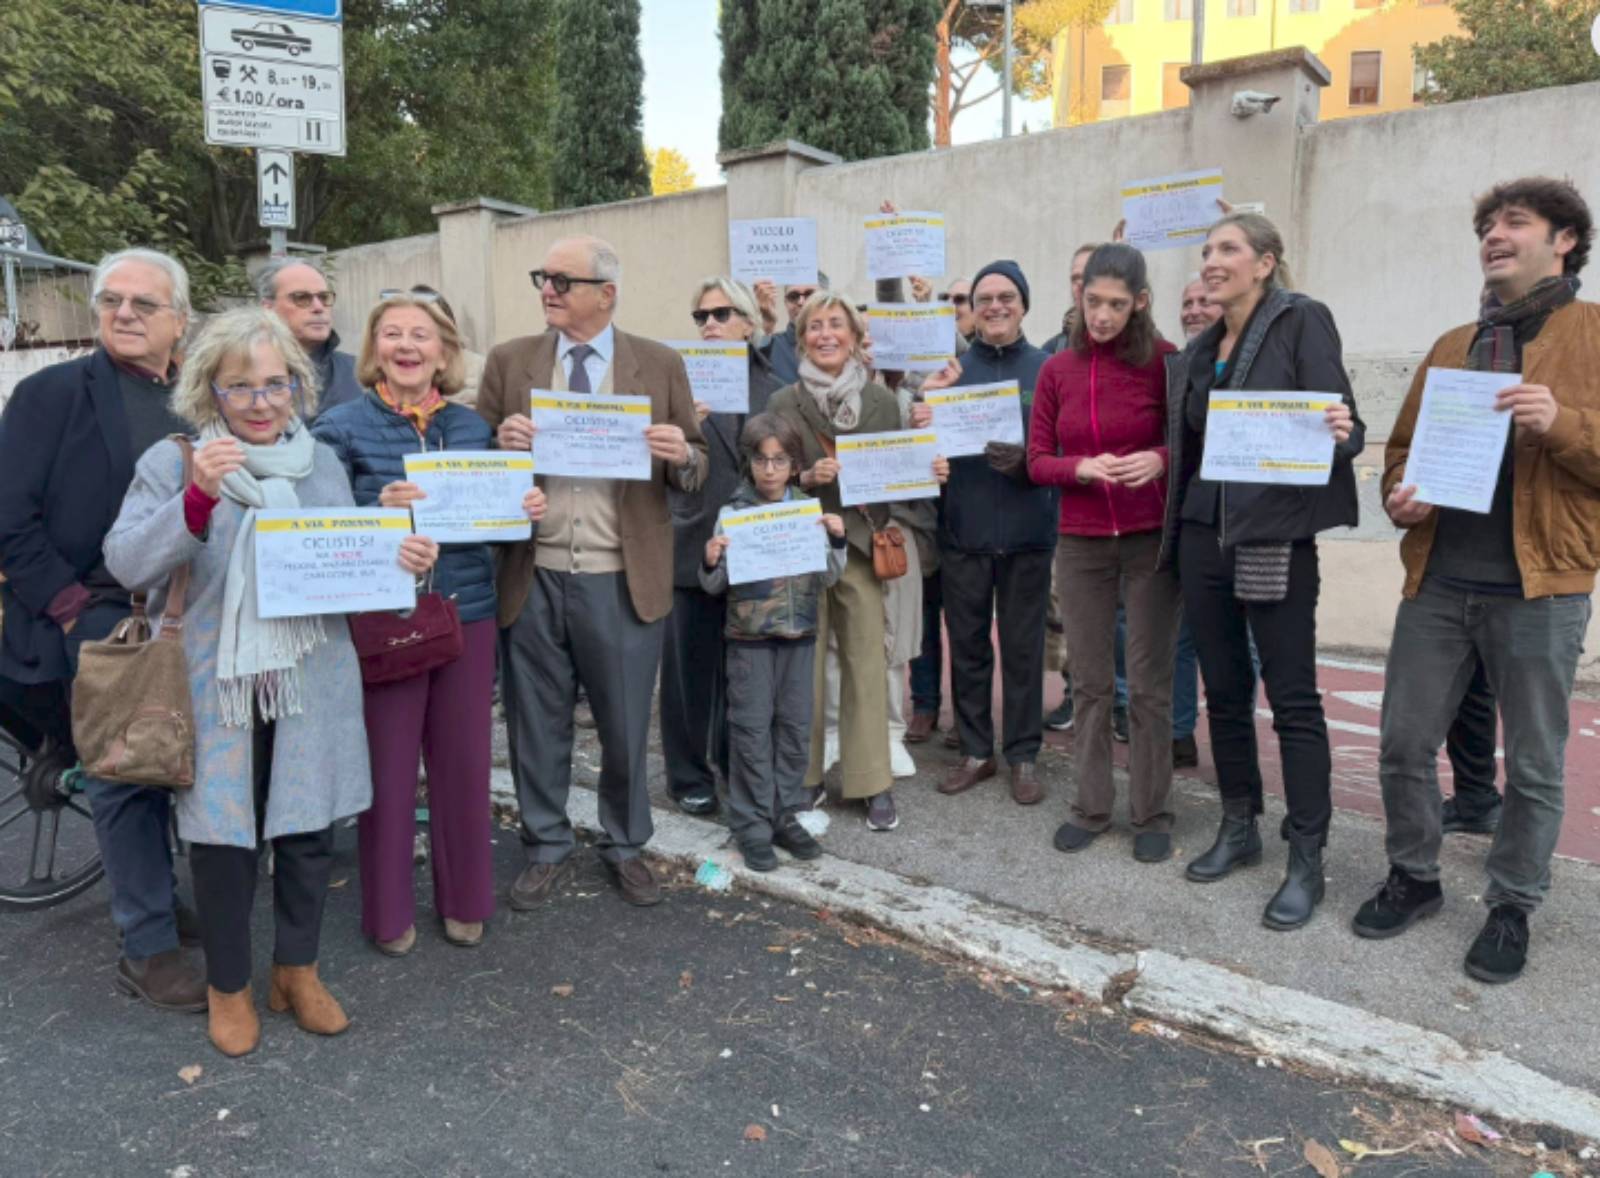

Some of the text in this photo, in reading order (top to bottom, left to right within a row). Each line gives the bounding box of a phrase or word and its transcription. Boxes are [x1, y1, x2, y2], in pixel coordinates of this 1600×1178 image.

[291, 519, 381, 529] A VIA PANAMA
